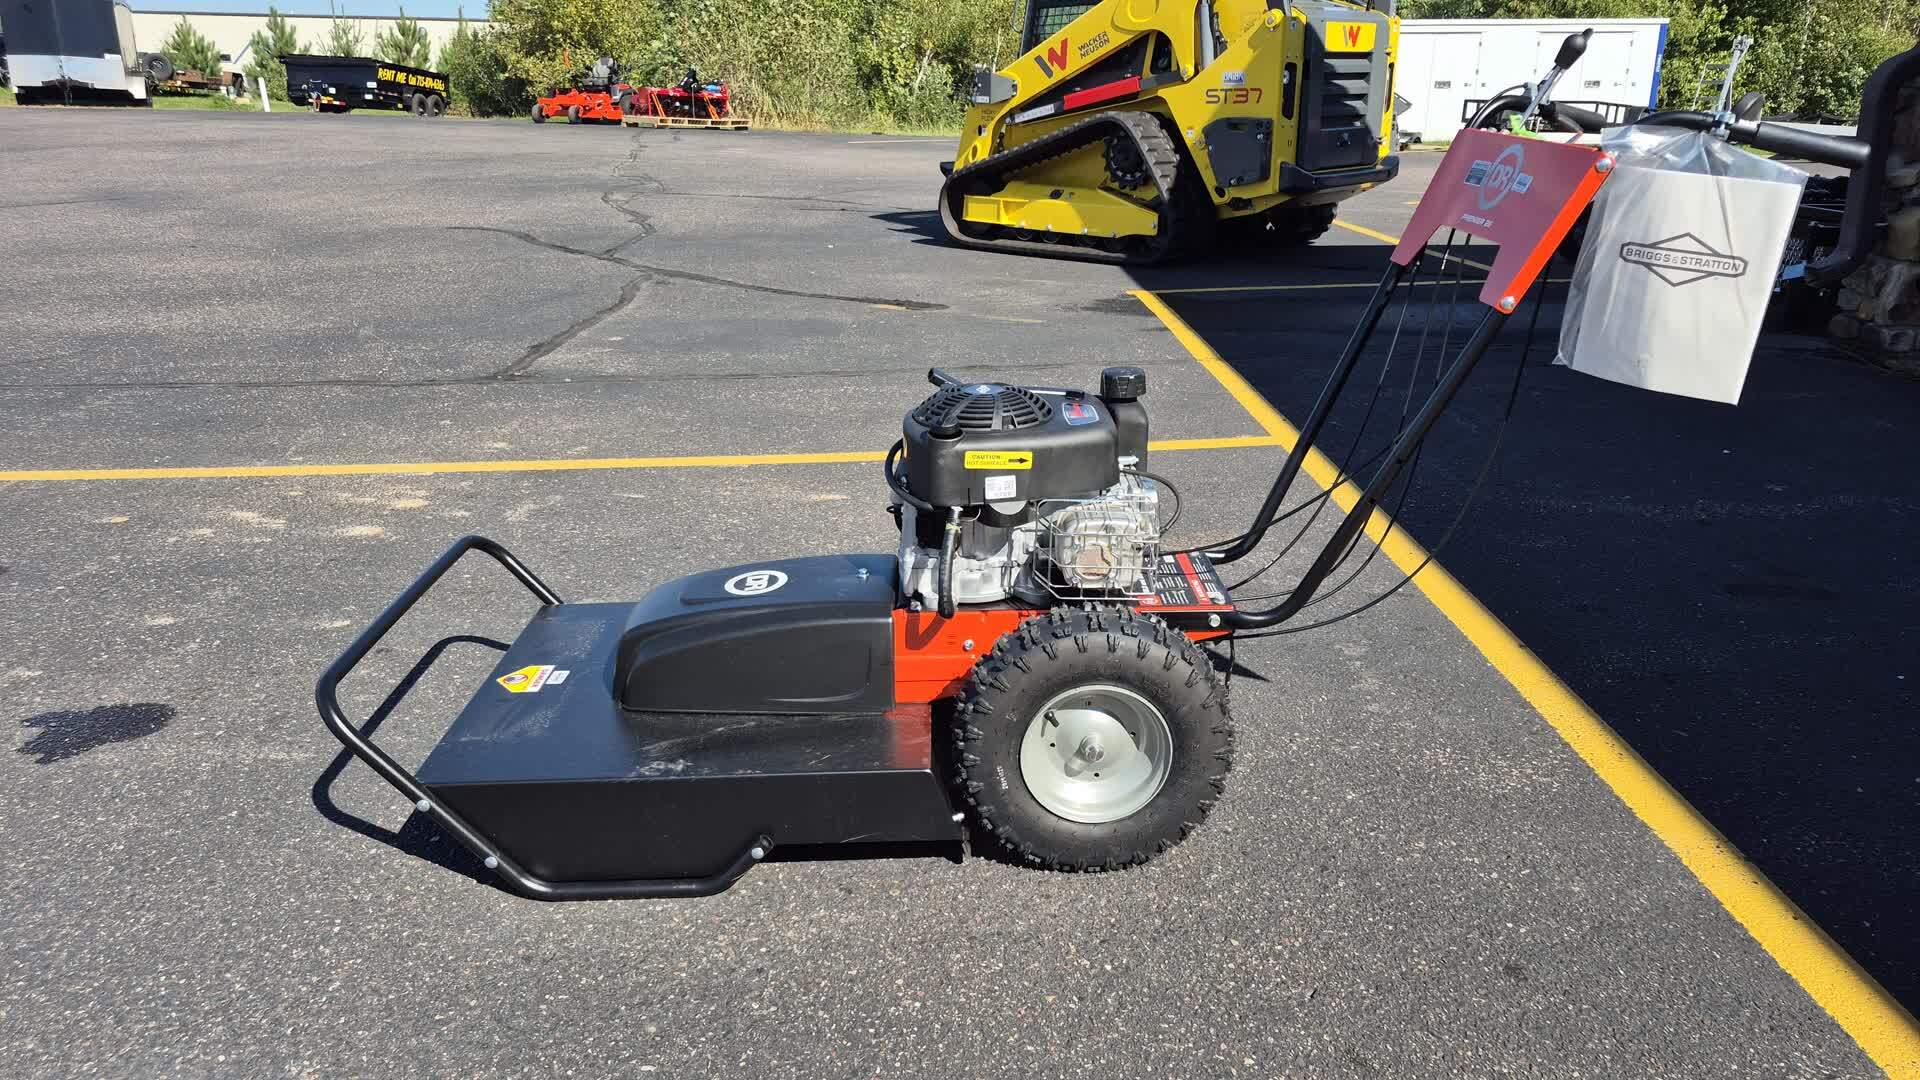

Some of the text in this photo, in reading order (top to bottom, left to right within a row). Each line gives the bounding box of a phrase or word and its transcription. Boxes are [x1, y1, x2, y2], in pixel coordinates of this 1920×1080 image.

[1078, 31, 1109, 52] WACKER
[1080, 37, 1110, 59] NEUSON
[377, 68, 396, 81] RENT
[396, 71, 407, 84] ME
[1205, 88, 1263, 104] ST37
[1488, 164, 1515, 191] DR
[743, 574, 769, 591] DR
